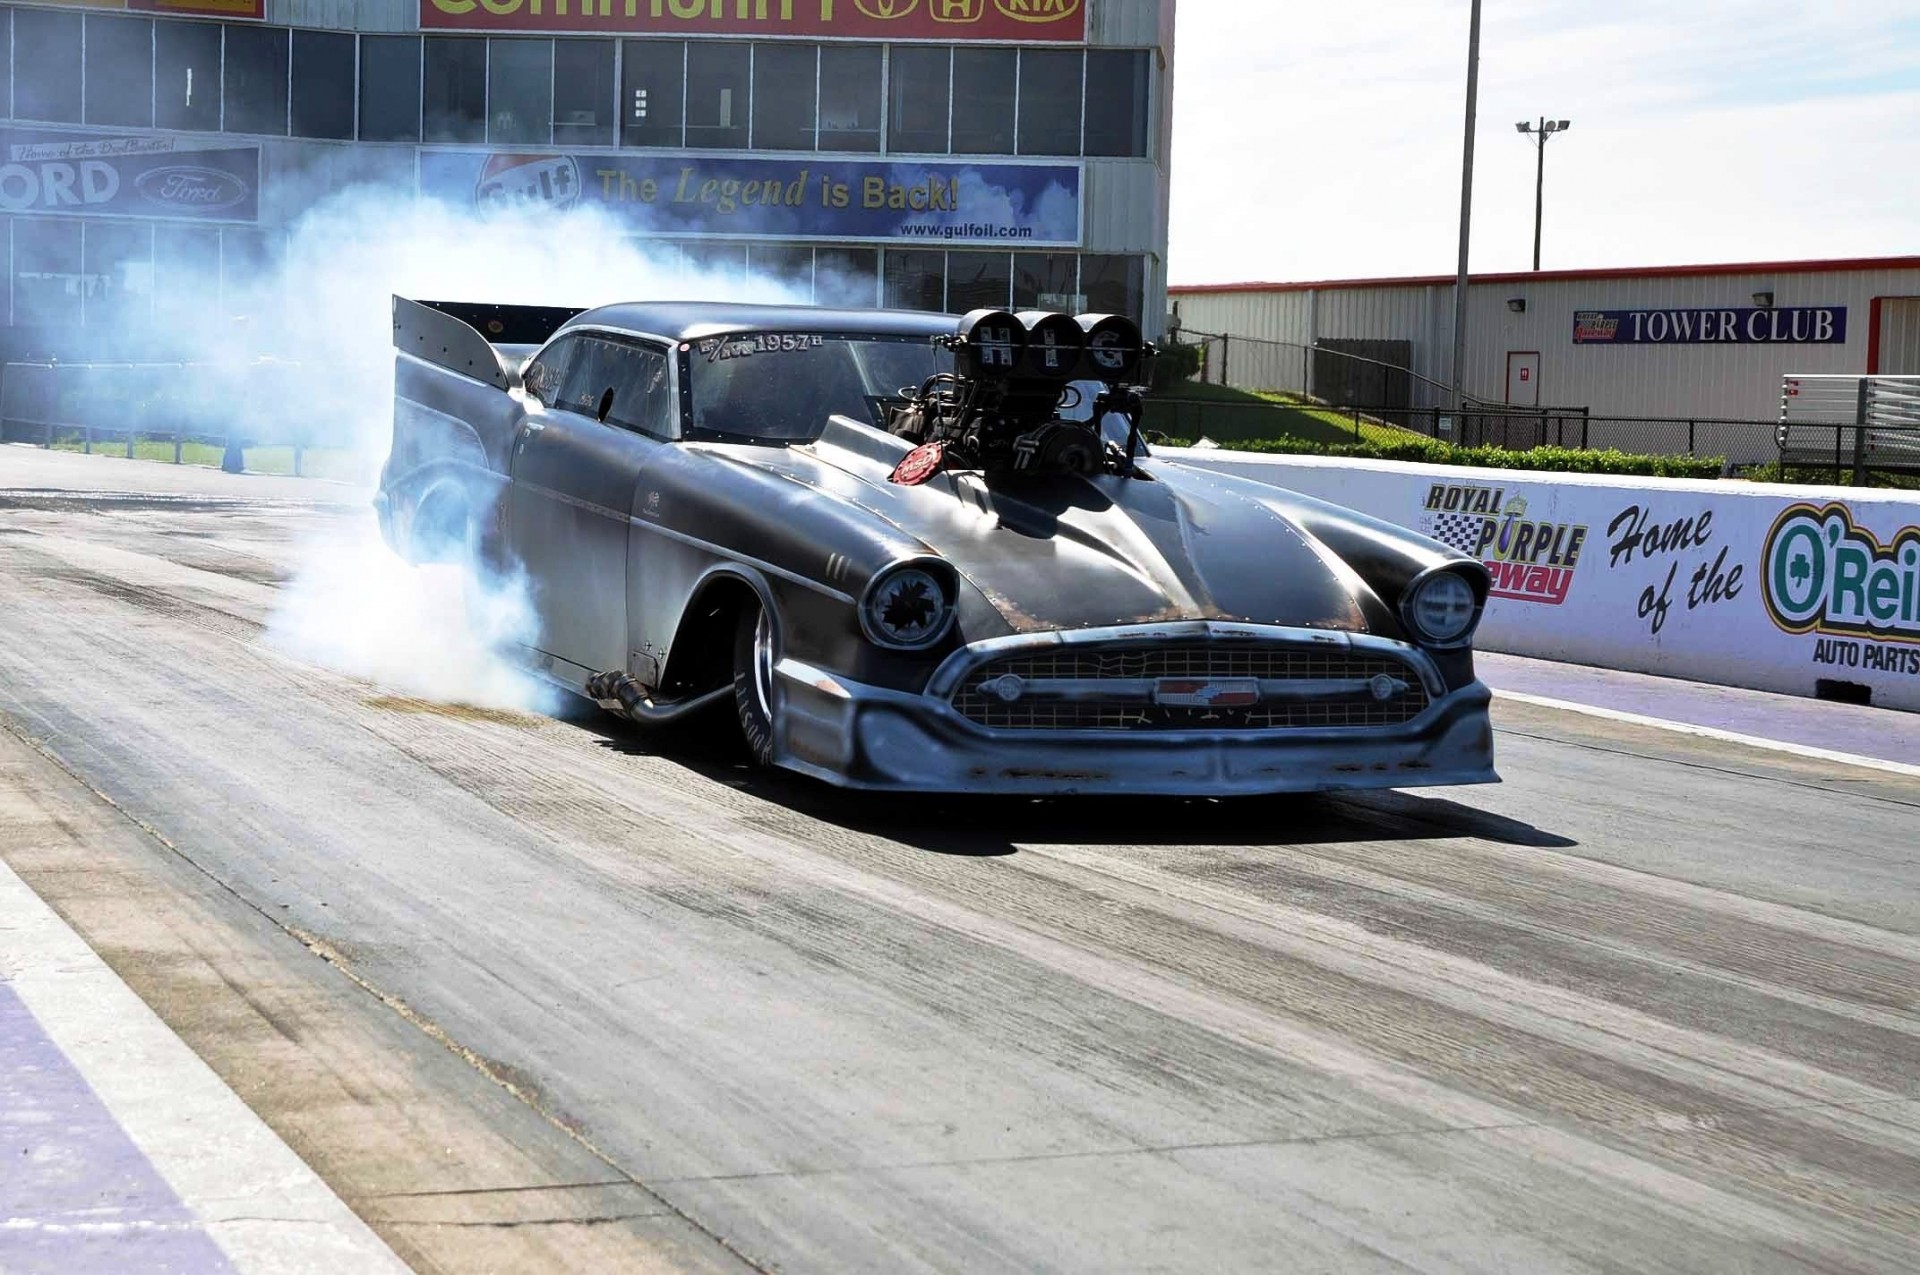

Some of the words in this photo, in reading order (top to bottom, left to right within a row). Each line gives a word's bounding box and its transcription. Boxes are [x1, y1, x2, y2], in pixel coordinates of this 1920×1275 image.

[160, 174, 222, 202] Ford
[596, 169, 658, 203] The
[672, 166, 808, 215] Legend
[821, 175, 849, 209] is
[862, 176, 959, 212] Back!
[900, 223, 1032, 239] www.gulfoil.com
[1629, 311, 1738, 342] TOWER
[1747, 309, 1834, 341] CLUB
[900, 455, 933, 476] MSD
[1425, 484, 1505, 515] ROYAL
[1474, 517, 1589, 568] PURPLE
[1606, 505, 1713, 568] Home
[1637, 561, 1678, 635] of
[1687, 545, 1744, 611] the
[1813, 638, 1860, 667] AUTO
[1862, 643, 1920, 676] PARTS
